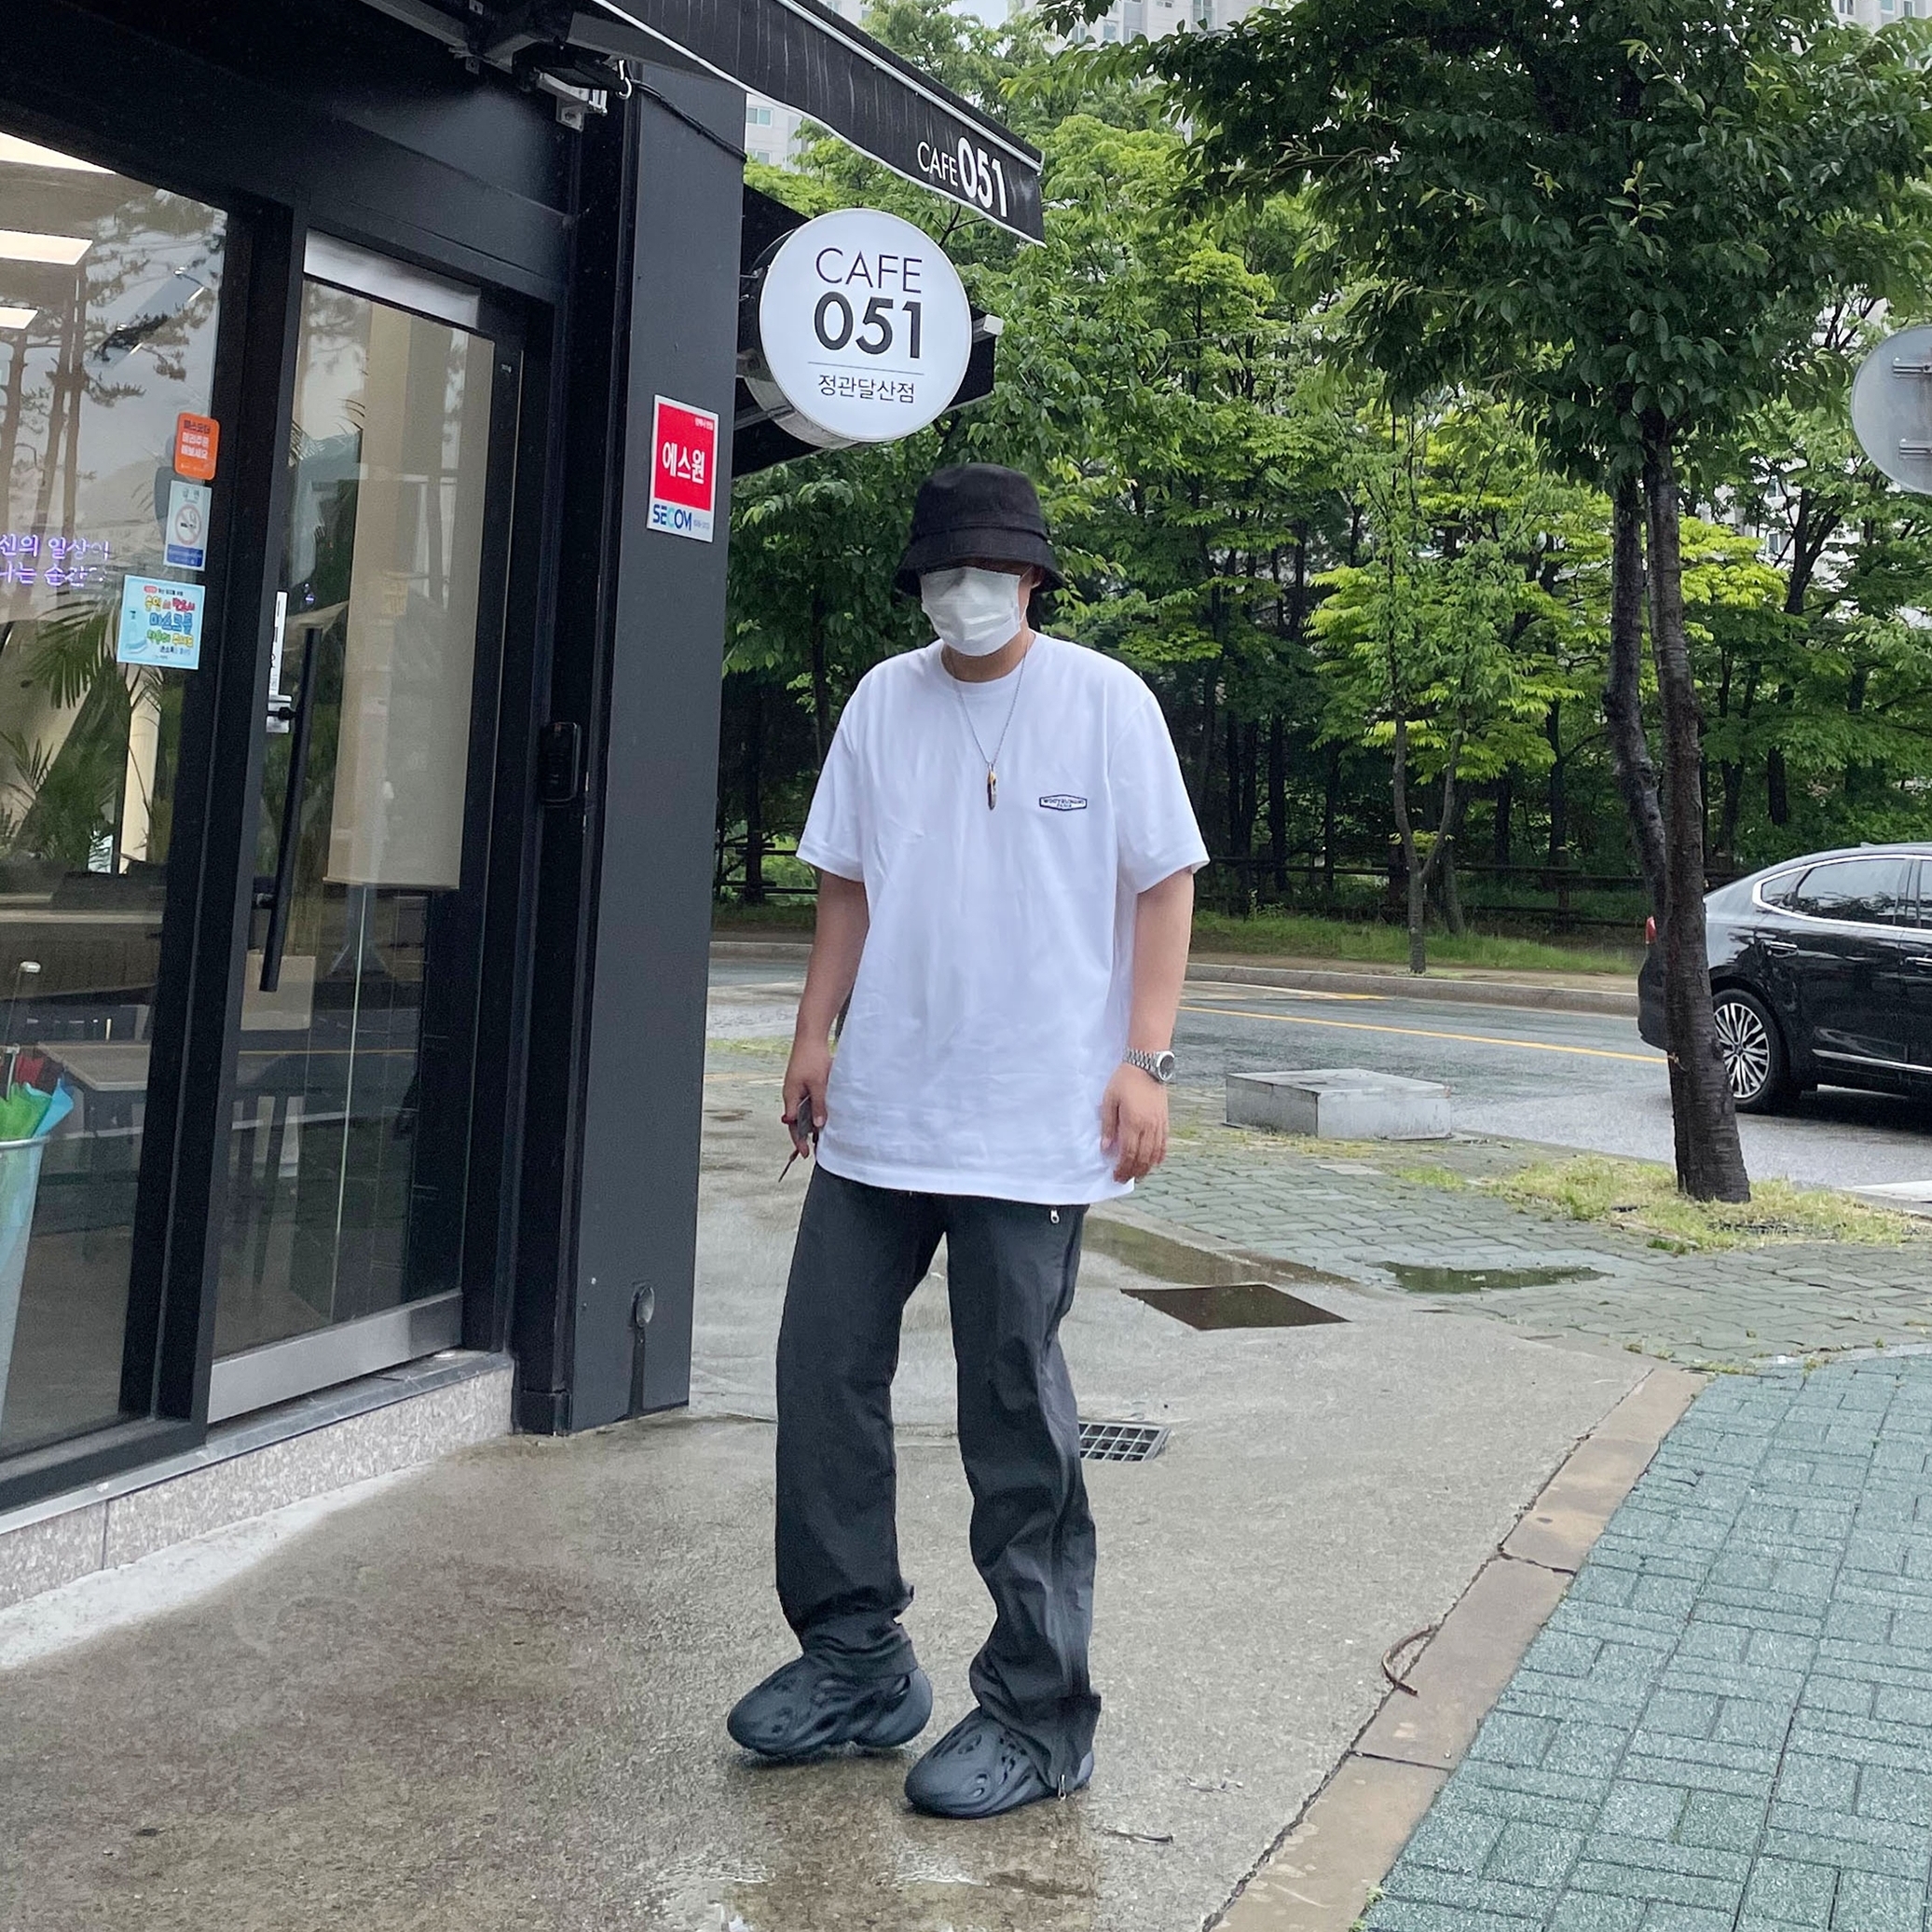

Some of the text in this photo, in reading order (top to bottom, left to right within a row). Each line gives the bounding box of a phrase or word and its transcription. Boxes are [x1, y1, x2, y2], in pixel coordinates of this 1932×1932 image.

[917, 137, 1007, 218] CAFE 051
[815, 247, 923, 294] CAFE
[814, 291, 922, 359] 051
[817, 374, 915, 404] 정관달산점
[663, 441, 706, 485] 에스원
[653, 504, 692, 531] SECOM
